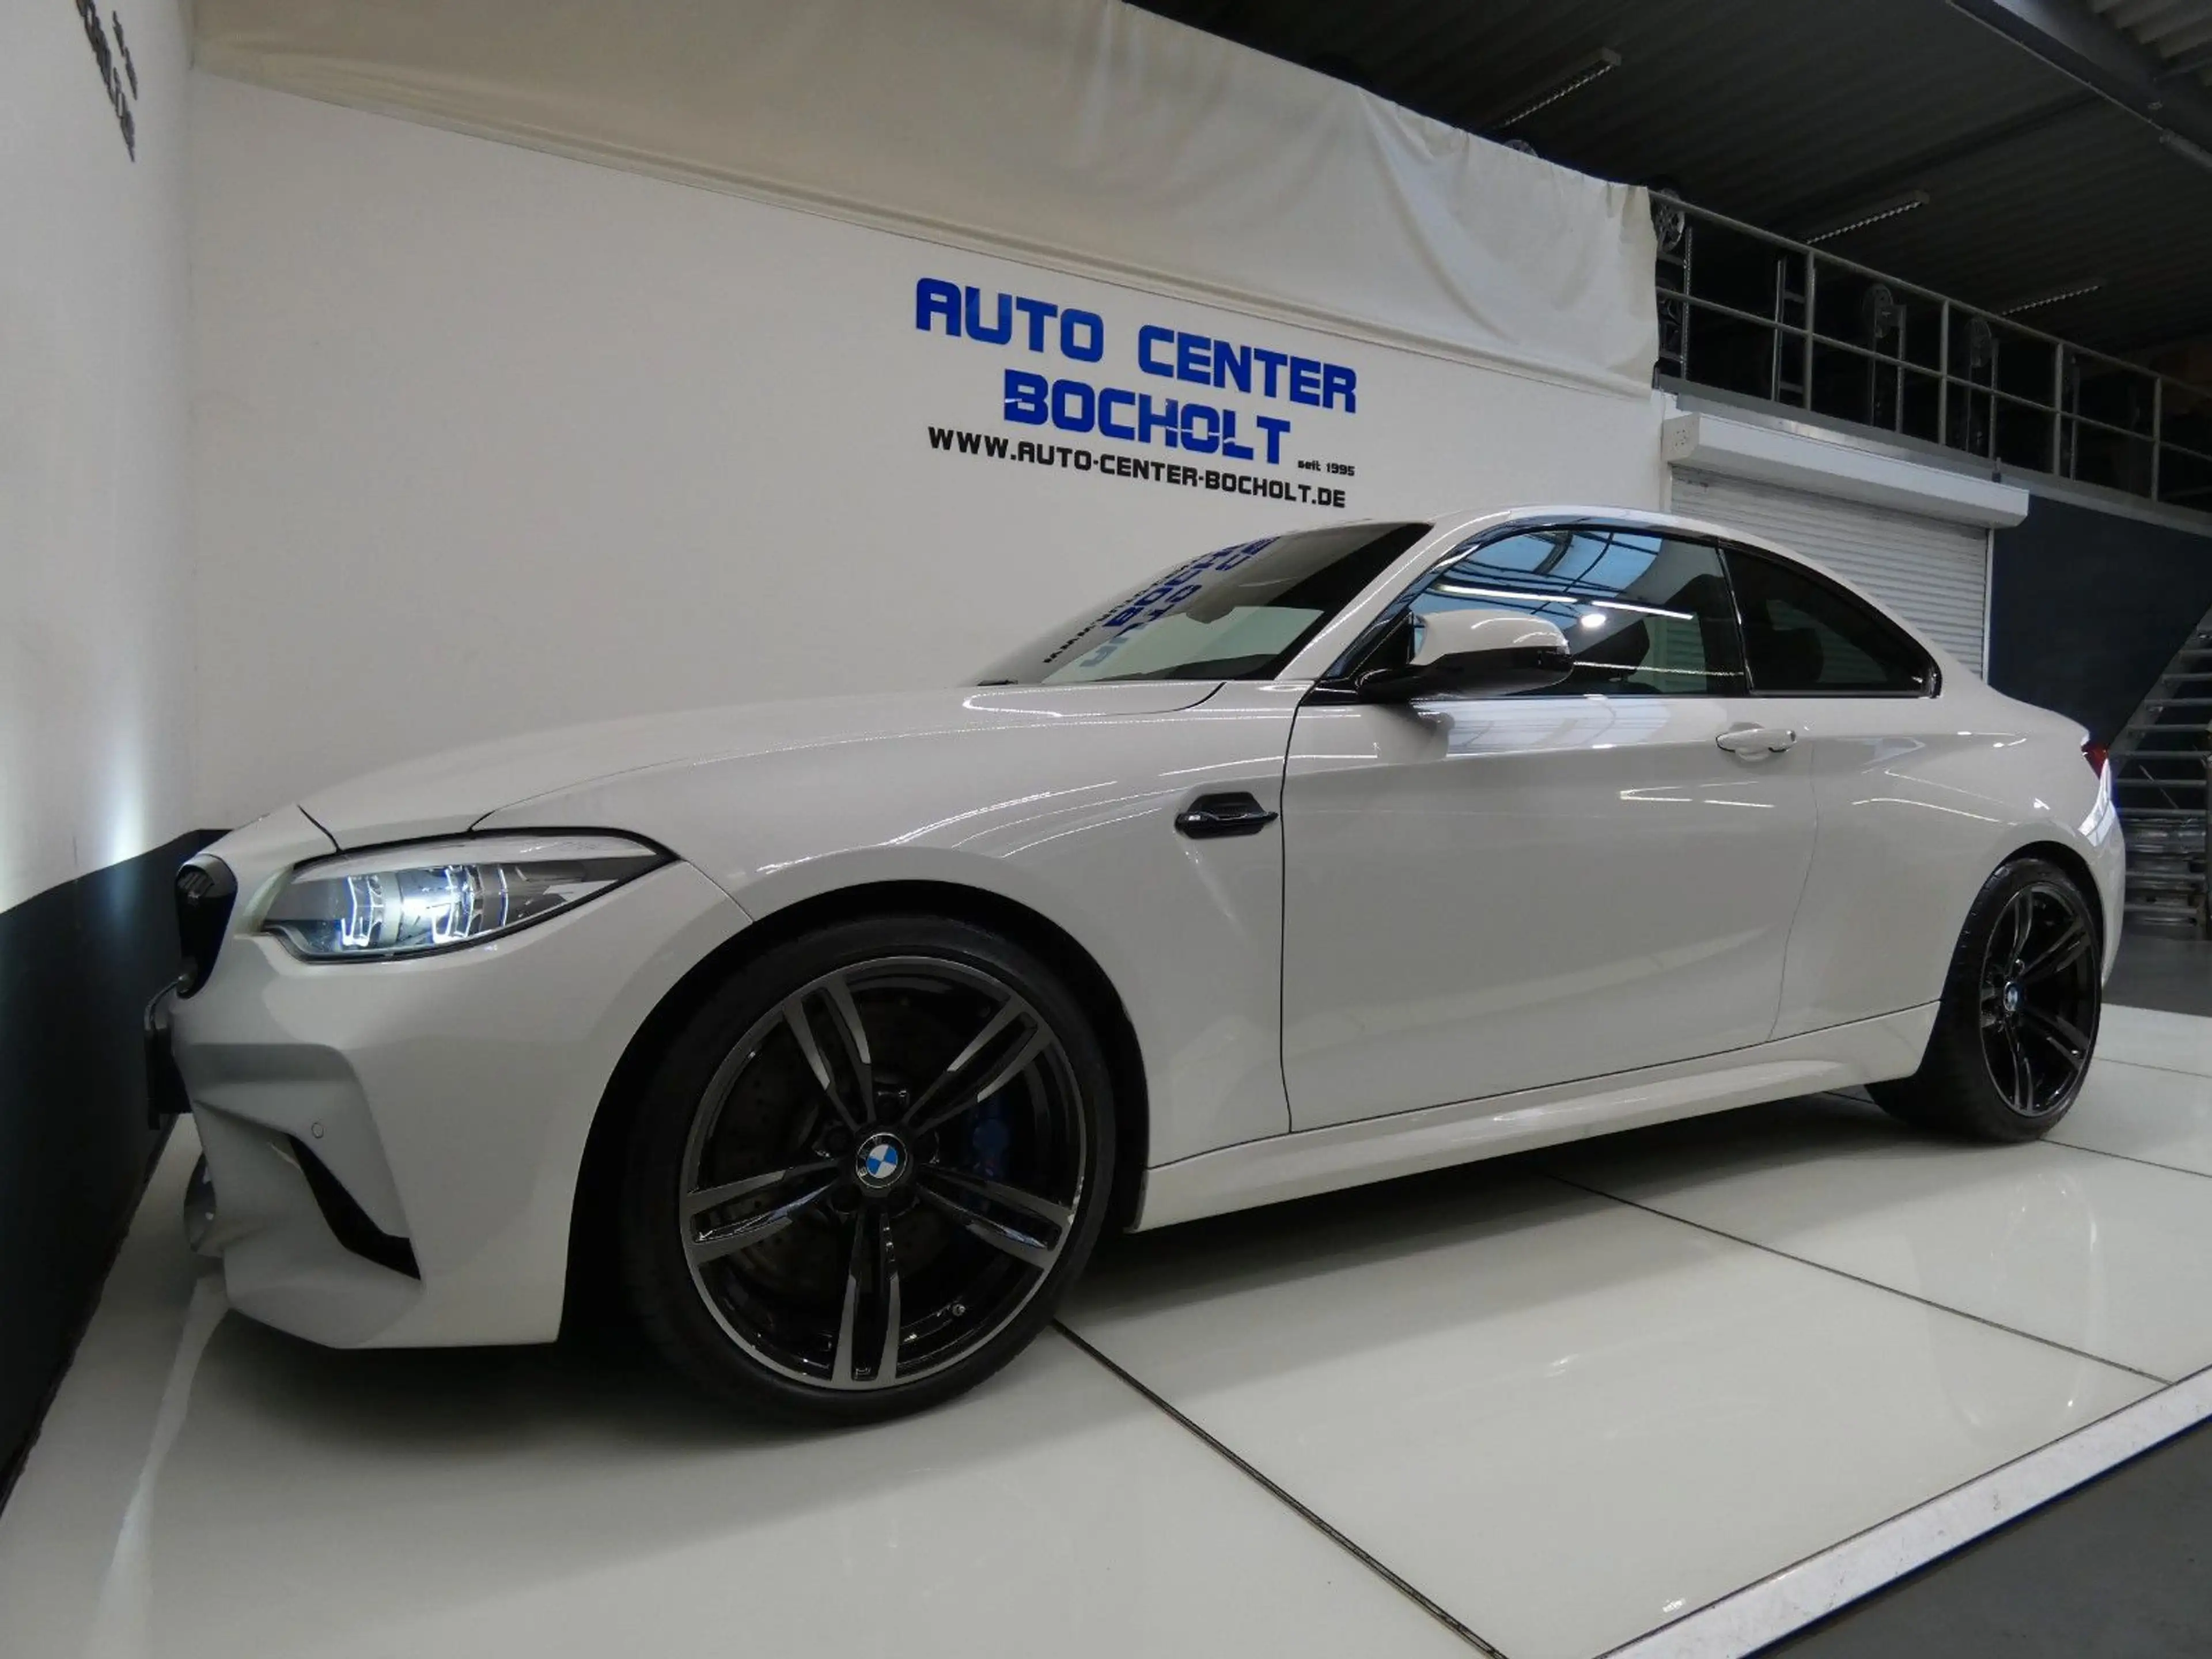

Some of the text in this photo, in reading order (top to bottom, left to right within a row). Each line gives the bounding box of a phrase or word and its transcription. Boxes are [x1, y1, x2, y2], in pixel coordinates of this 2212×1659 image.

[916, 278, 1357, 414] AUTO CENTER
[1003, 369, 1291, 465] BOCHOLT
[928, 426, 1346, 508] WWW.AUTO-CENTER-BOCHOLT.DE
[1298, 460, 1355, 476] seit 1995
